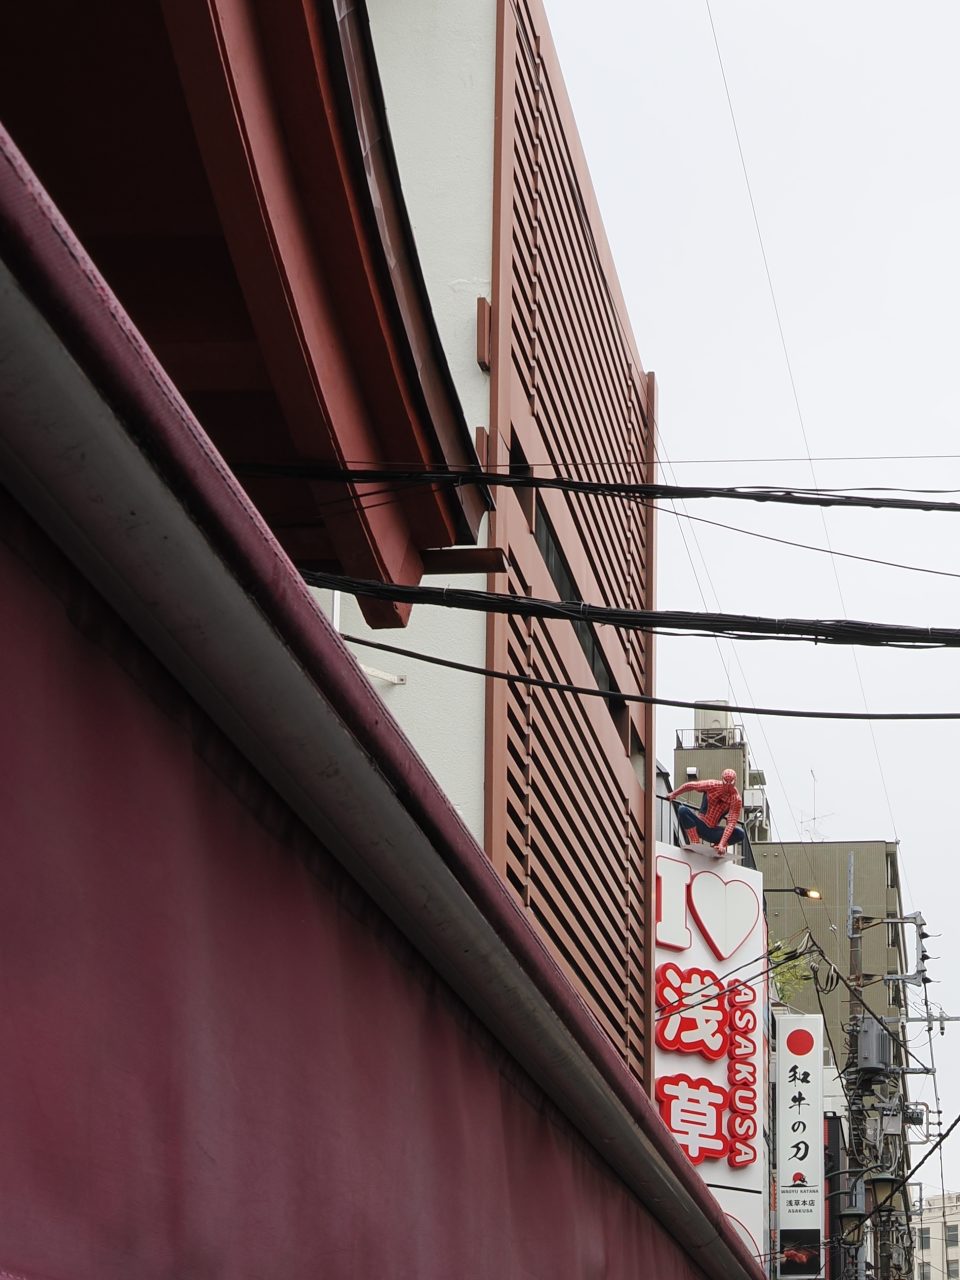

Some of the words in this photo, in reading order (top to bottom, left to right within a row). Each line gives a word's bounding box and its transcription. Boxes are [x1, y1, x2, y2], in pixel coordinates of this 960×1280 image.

[657, 965, 729, 1162] 浅草
[728, 979, 758, 1168] ASAKUSA
[788, 1064, 811, 1161] 和牛の刀
